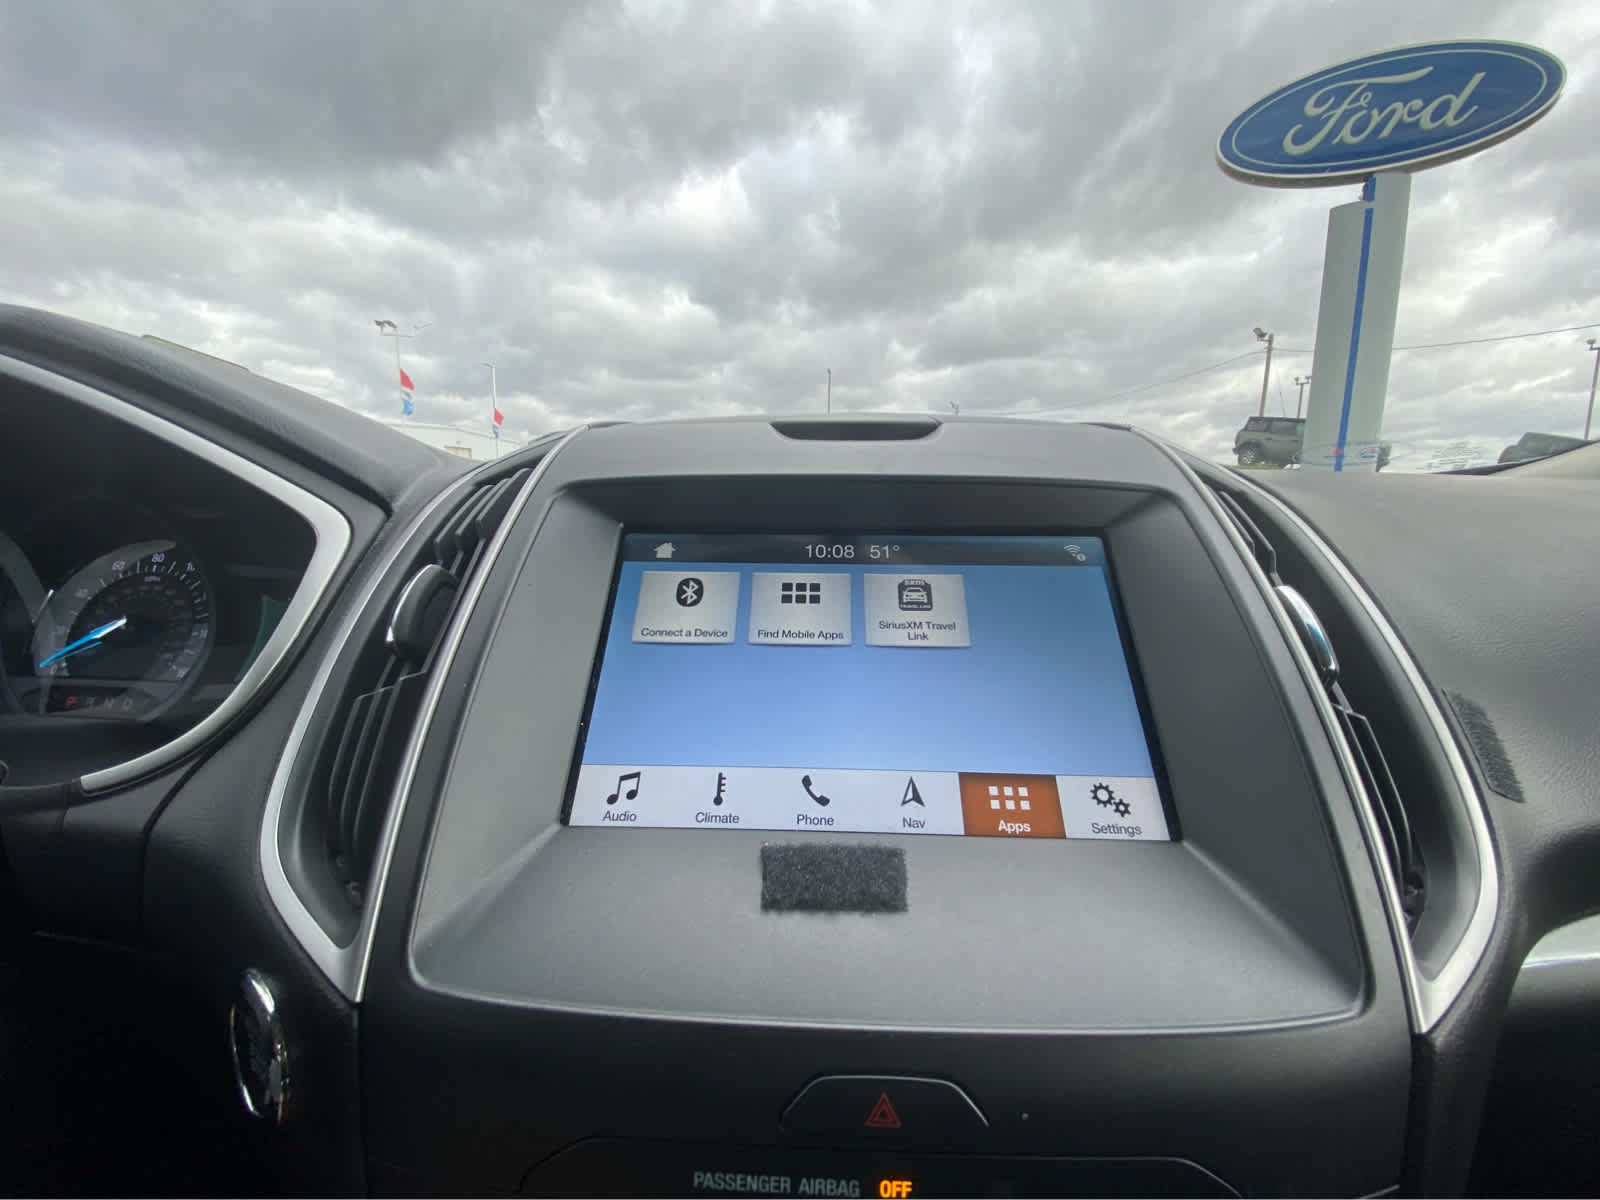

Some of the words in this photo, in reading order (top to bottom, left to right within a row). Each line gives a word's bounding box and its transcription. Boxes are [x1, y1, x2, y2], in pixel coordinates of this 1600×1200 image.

[1282, 66, 1487, 156] Ford
[804, 544, 855, 559] 10:08
[869, 544, 901, 559] 51°
[878, 620, 924, 630] SiriusXM
[926, 621, 956, 631] Travel
[640, 627, 684, 638] Connect
[687, 629, 692, 638] a
[694, 628, 728, 639] Device
[757, 629, 779, 640] Find
[781, 629, 816, 641] Mobile
[818, 630, 844, 643] Apps
[907, 631, 929, 641] Link
[602, 810, 637, 823] Audio
[695, 812, 740, 825] Climate
[796, 814, 835, 827] Phone
[902, 817, 926, 830] Nav
[998, 820, 1031, 834] Apps
[1091, 822, 1142, 837] Settings
[693, 1171, 792, 1194] PASSENGER
[799, 1177, 861, 1198] AIRBAG
[879, 1179, 913, 1199] OFF
